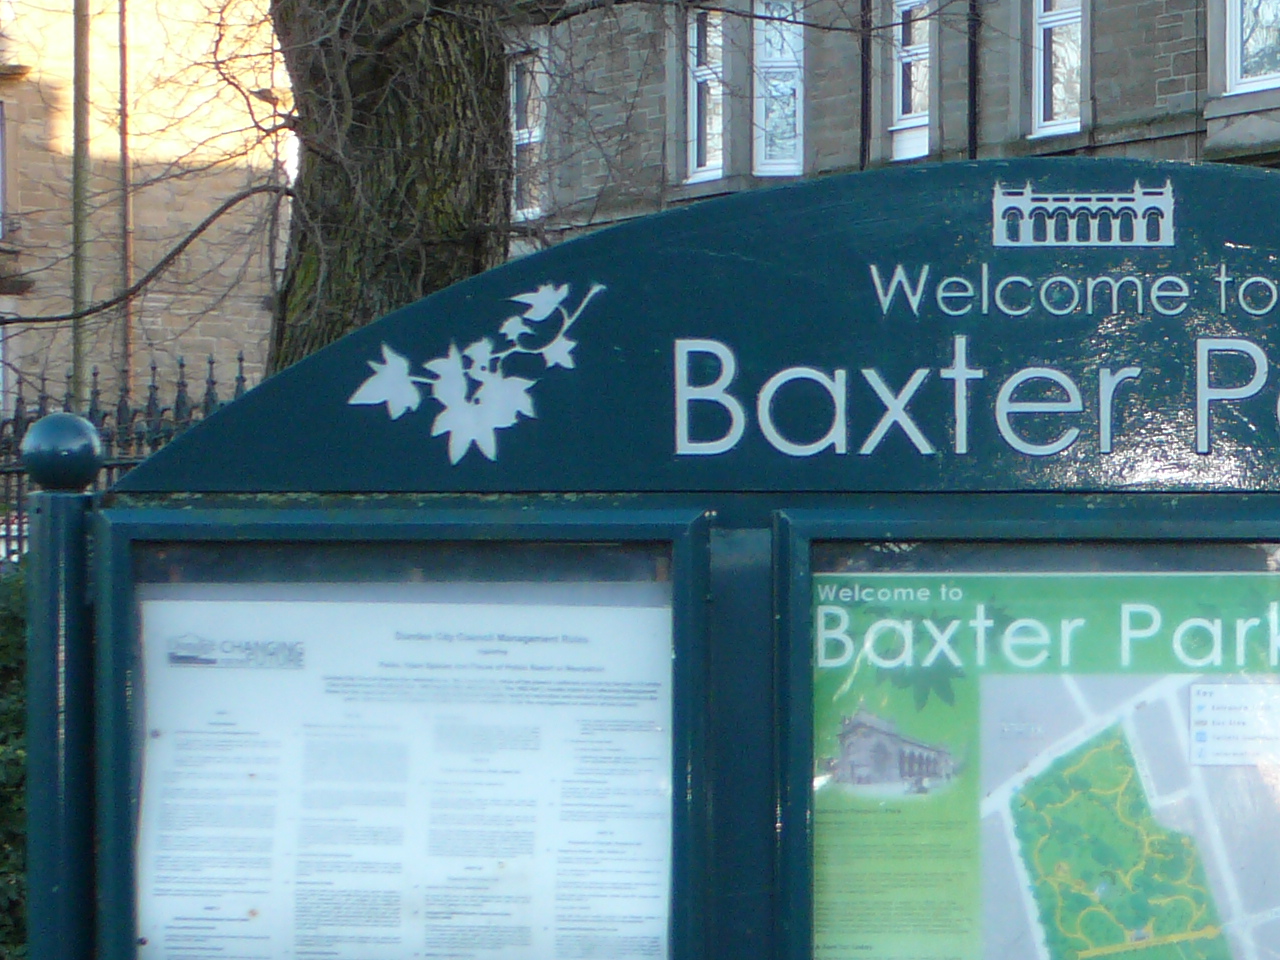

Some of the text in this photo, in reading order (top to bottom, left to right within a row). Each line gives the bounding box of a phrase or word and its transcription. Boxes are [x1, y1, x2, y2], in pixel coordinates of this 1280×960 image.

[869, 263, 1279, 317] Welcome to
[674, 335, 1141, 456] Baxter
[817, 584, 963, 602] Welcome to
[815, 602, 1087, 668] Baxter
